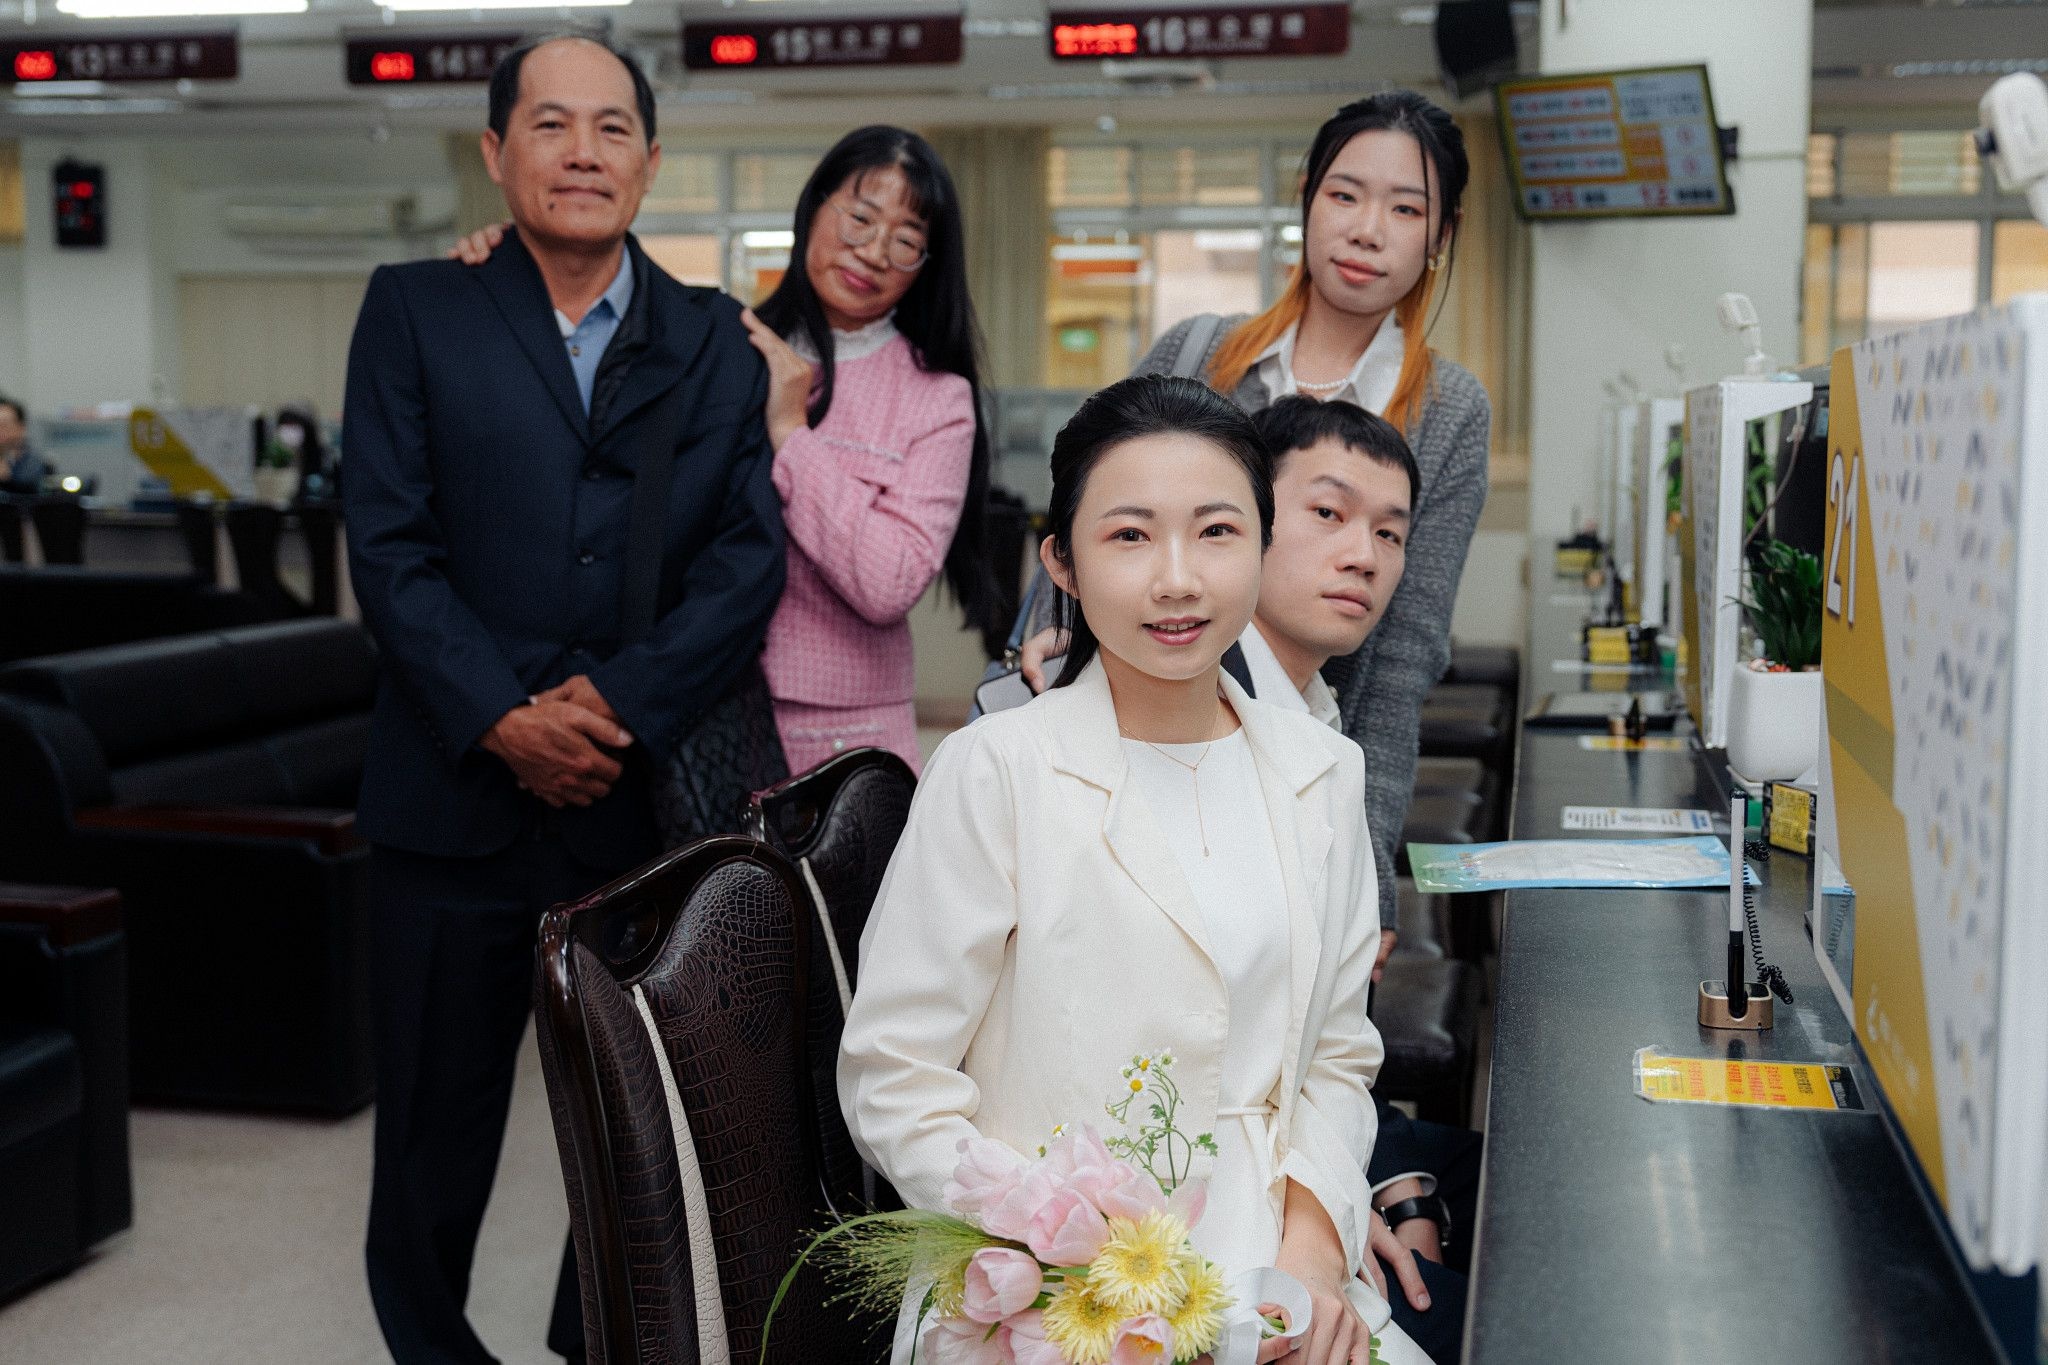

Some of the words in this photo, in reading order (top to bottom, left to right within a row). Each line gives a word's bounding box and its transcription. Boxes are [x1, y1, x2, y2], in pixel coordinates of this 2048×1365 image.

[772, 27, 812, 63] 15
[1145, 16, 1186, 54] 16
[1826, 452, 1860, 624] 21
